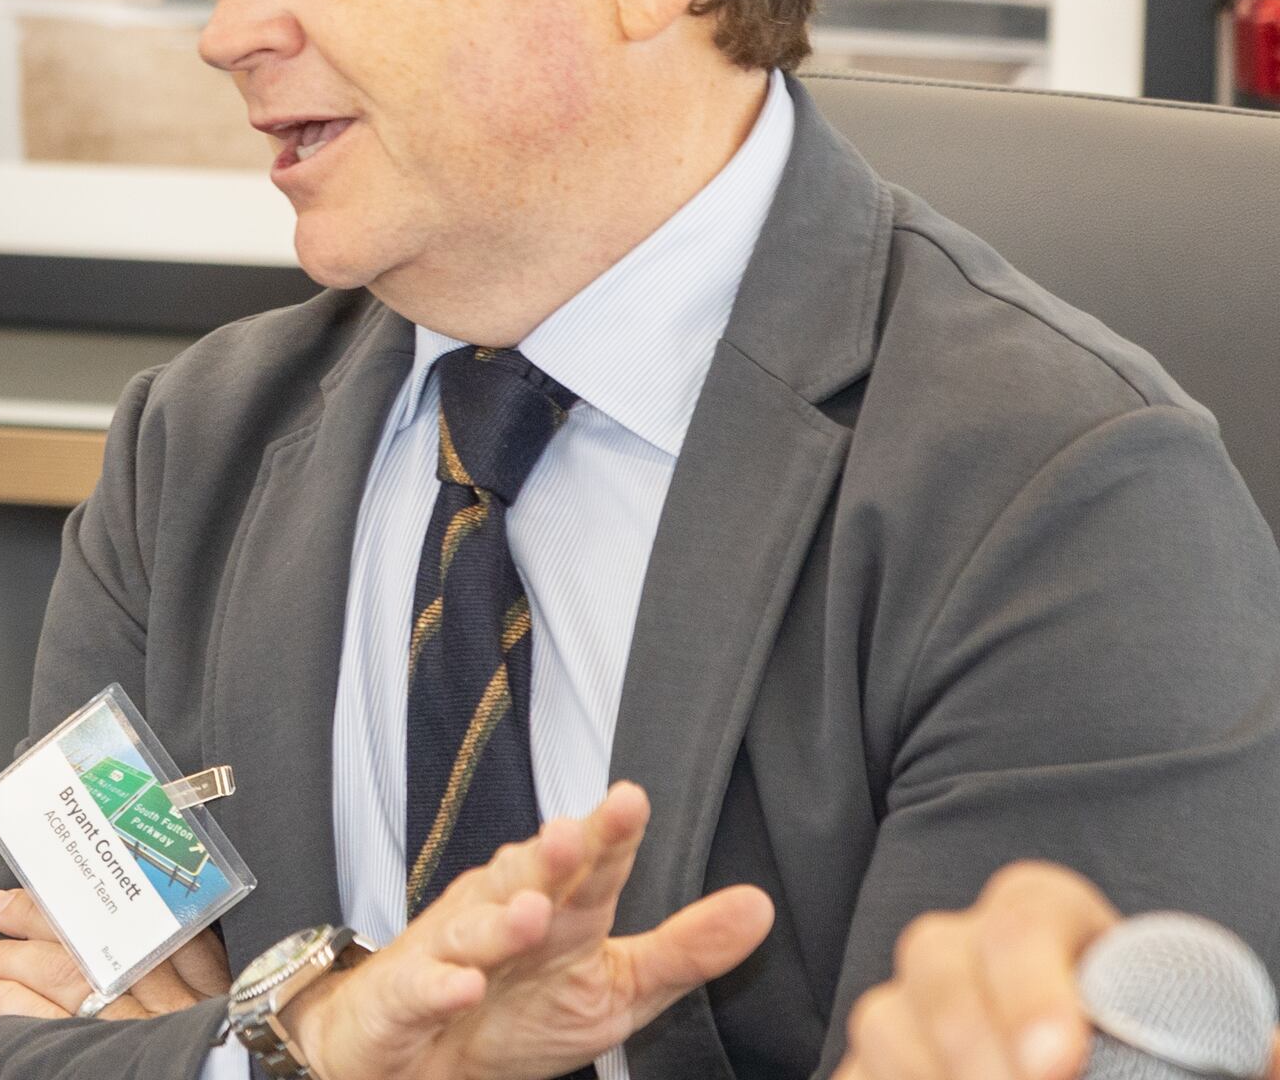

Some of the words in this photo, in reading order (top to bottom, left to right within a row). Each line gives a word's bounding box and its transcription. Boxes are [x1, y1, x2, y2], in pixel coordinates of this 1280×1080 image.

[59, 786, 99, 841] Bryant
[95, 839, 141, 901] Cornett
[130, 816, 175, 847] Parkway
[134, 803, 160, 822] South
[160, 818, 193, 840] Fulton
[44, 810, 70, 843] ACBR
[65, 841, 96, 880] Broker
[93, 879, 118, 914] Team
